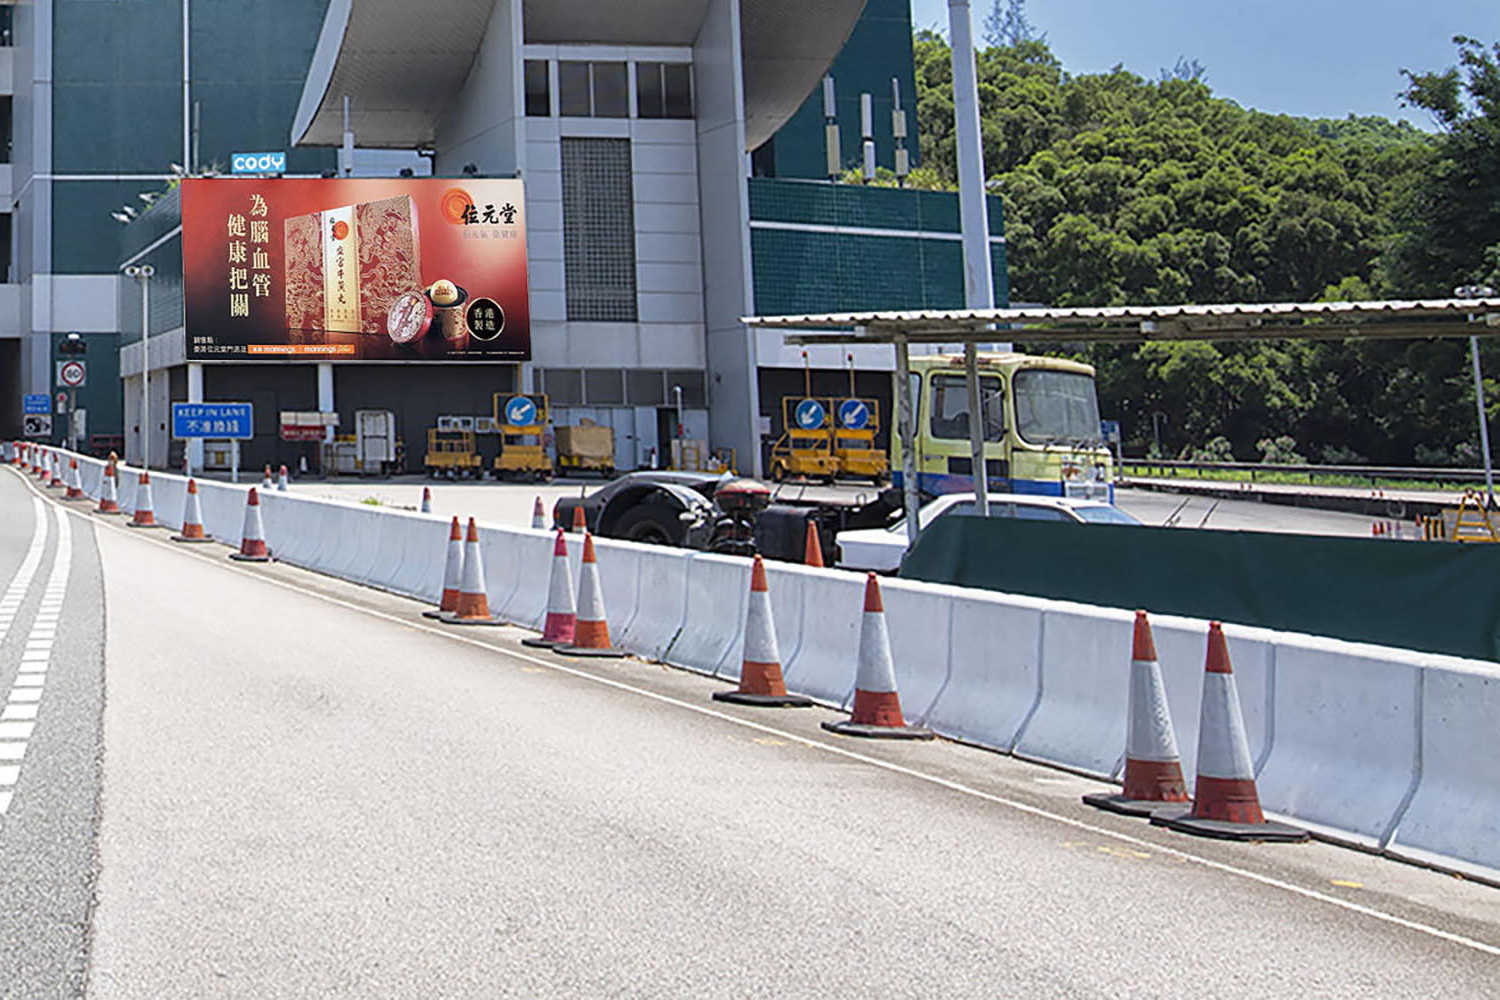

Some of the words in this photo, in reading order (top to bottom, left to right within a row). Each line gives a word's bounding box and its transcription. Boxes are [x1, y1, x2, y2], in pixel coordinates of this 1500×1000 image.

[234, 153, 284, 170] cody
[461, 203, 518, 226] 位元堂
[250, 193, 271, 297] 為腦血管
[227, 213, 249, 317] 健康把關
[474, 307, 495, 319] 香港
[178, 408, 204, 417] KEEP
[206, 408, 217, 417] IN
[220, 408, 246, 417] LANE
